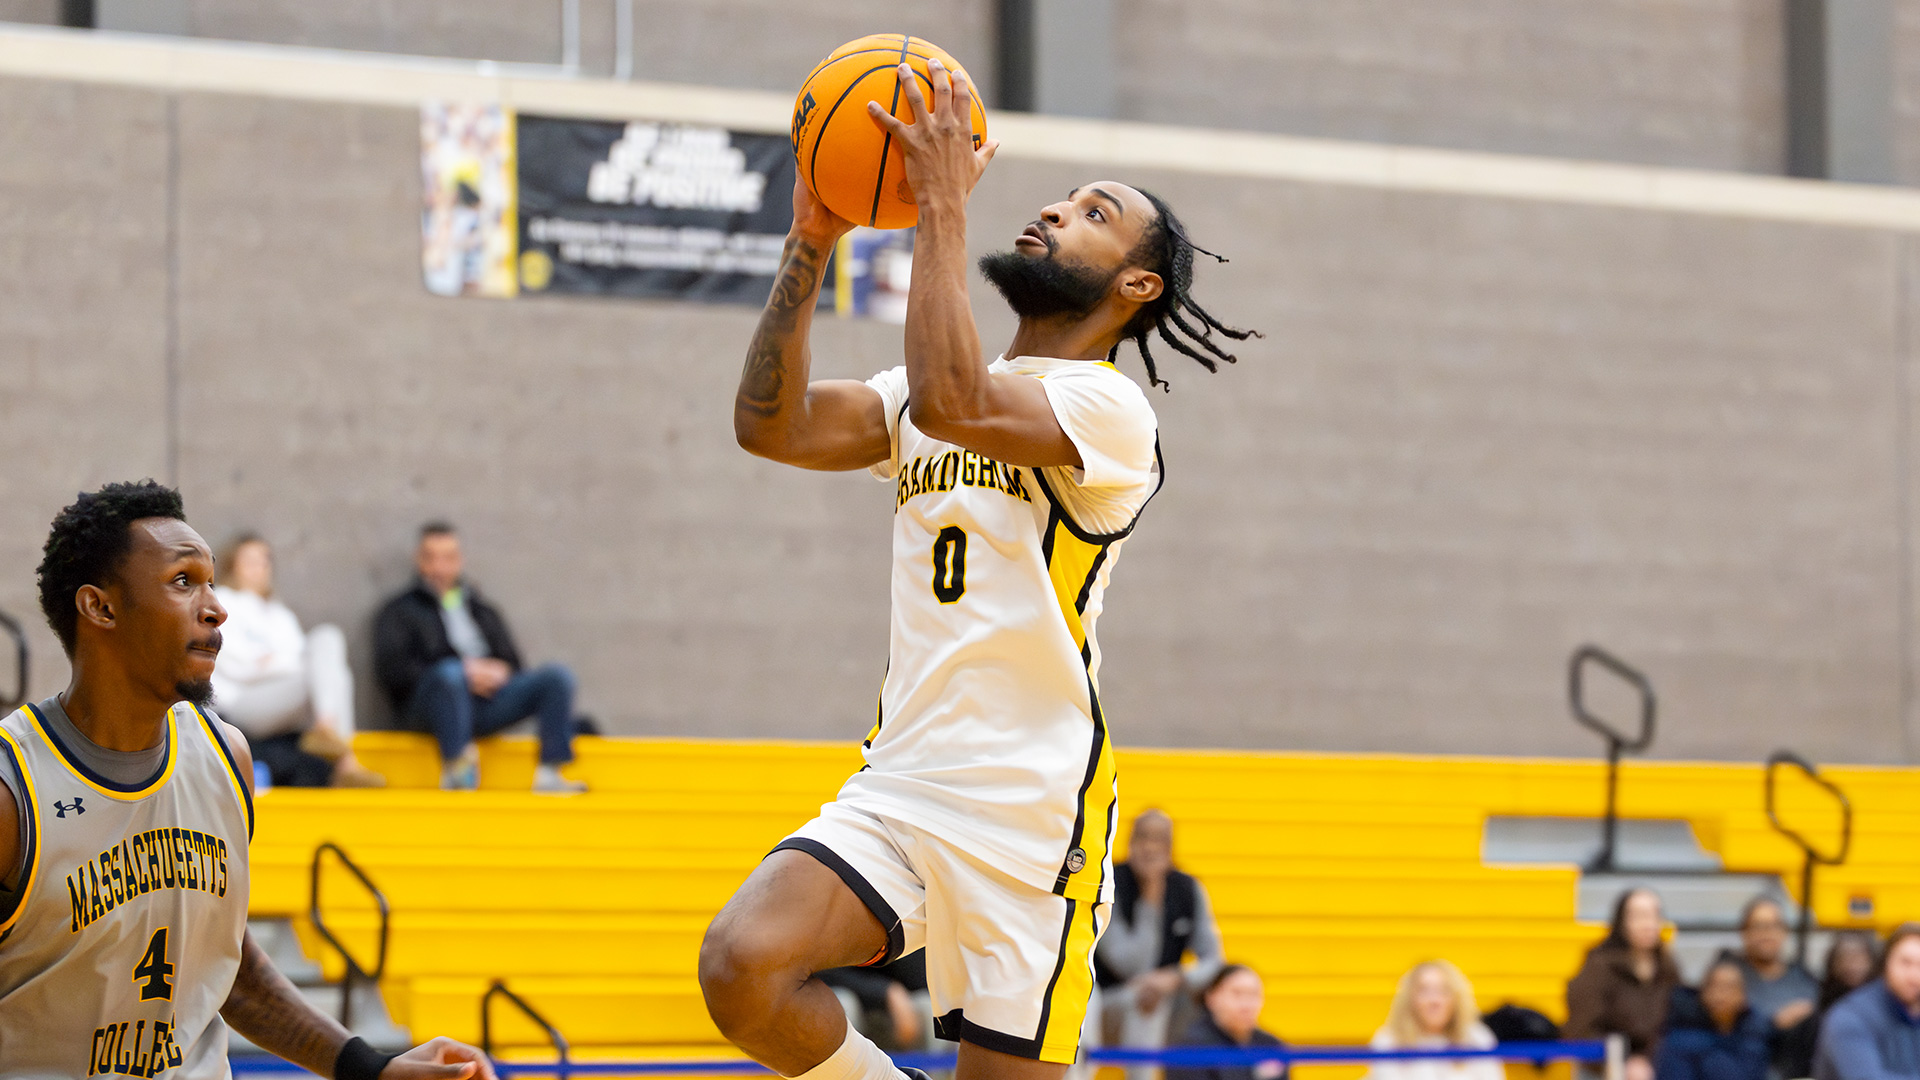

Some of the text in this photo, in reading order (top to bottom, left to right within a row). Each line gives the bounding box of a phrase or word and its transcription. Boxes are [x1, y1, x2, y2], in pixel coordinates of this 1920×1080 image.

[932, 524, 967, 604] 0
[66, 827, 228, 934] MASSACHUSETTS
[132, 926, 175, 1003] 4
